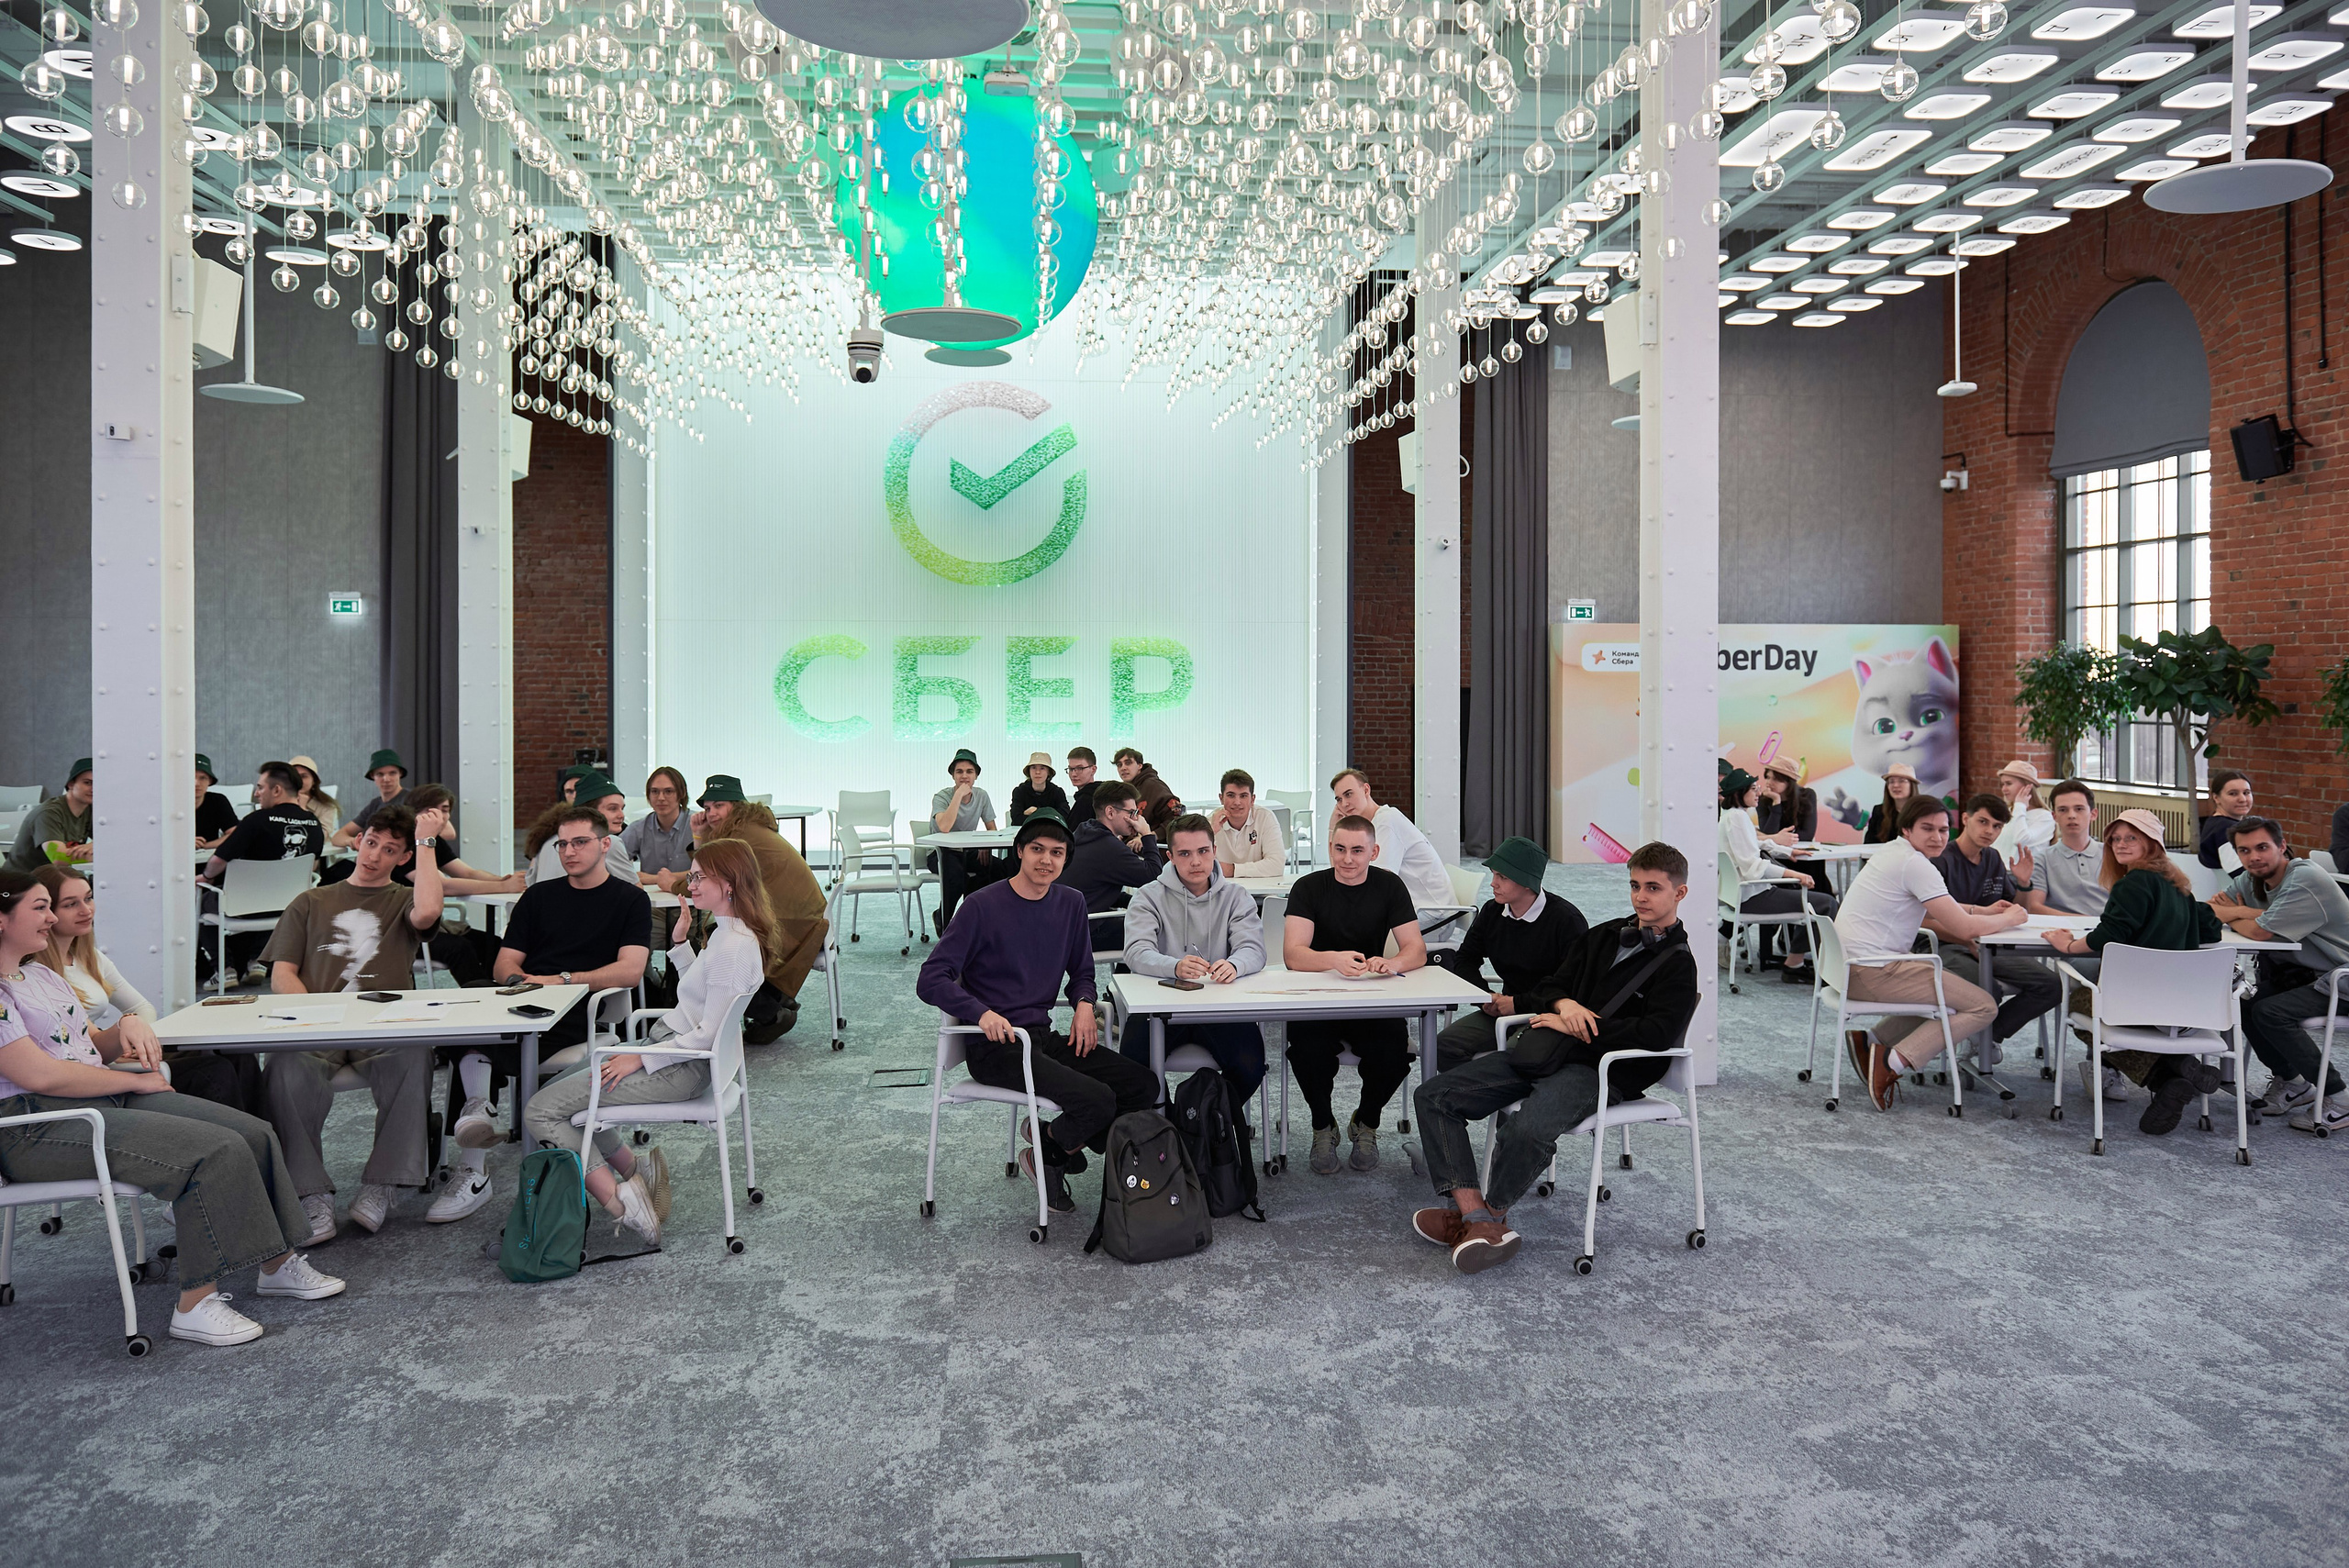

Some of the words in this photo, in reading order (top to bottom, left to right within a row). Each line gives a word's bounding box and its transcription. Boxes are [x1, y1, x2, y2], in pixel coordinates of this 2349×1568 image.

[1787, 33, 1815, 48] Alt
[2266, 106, 2305, 119] F11
[1760, 131, 1794, 149] Shift
[2192, 139, 2230, 152] F12
[1611, 658, 1634, 666] Сбера
[1718, 641, 1818, 677] berDay
[773, 633, 1195, 743] СБЕР
[269, 816, 288, 824] KARL
